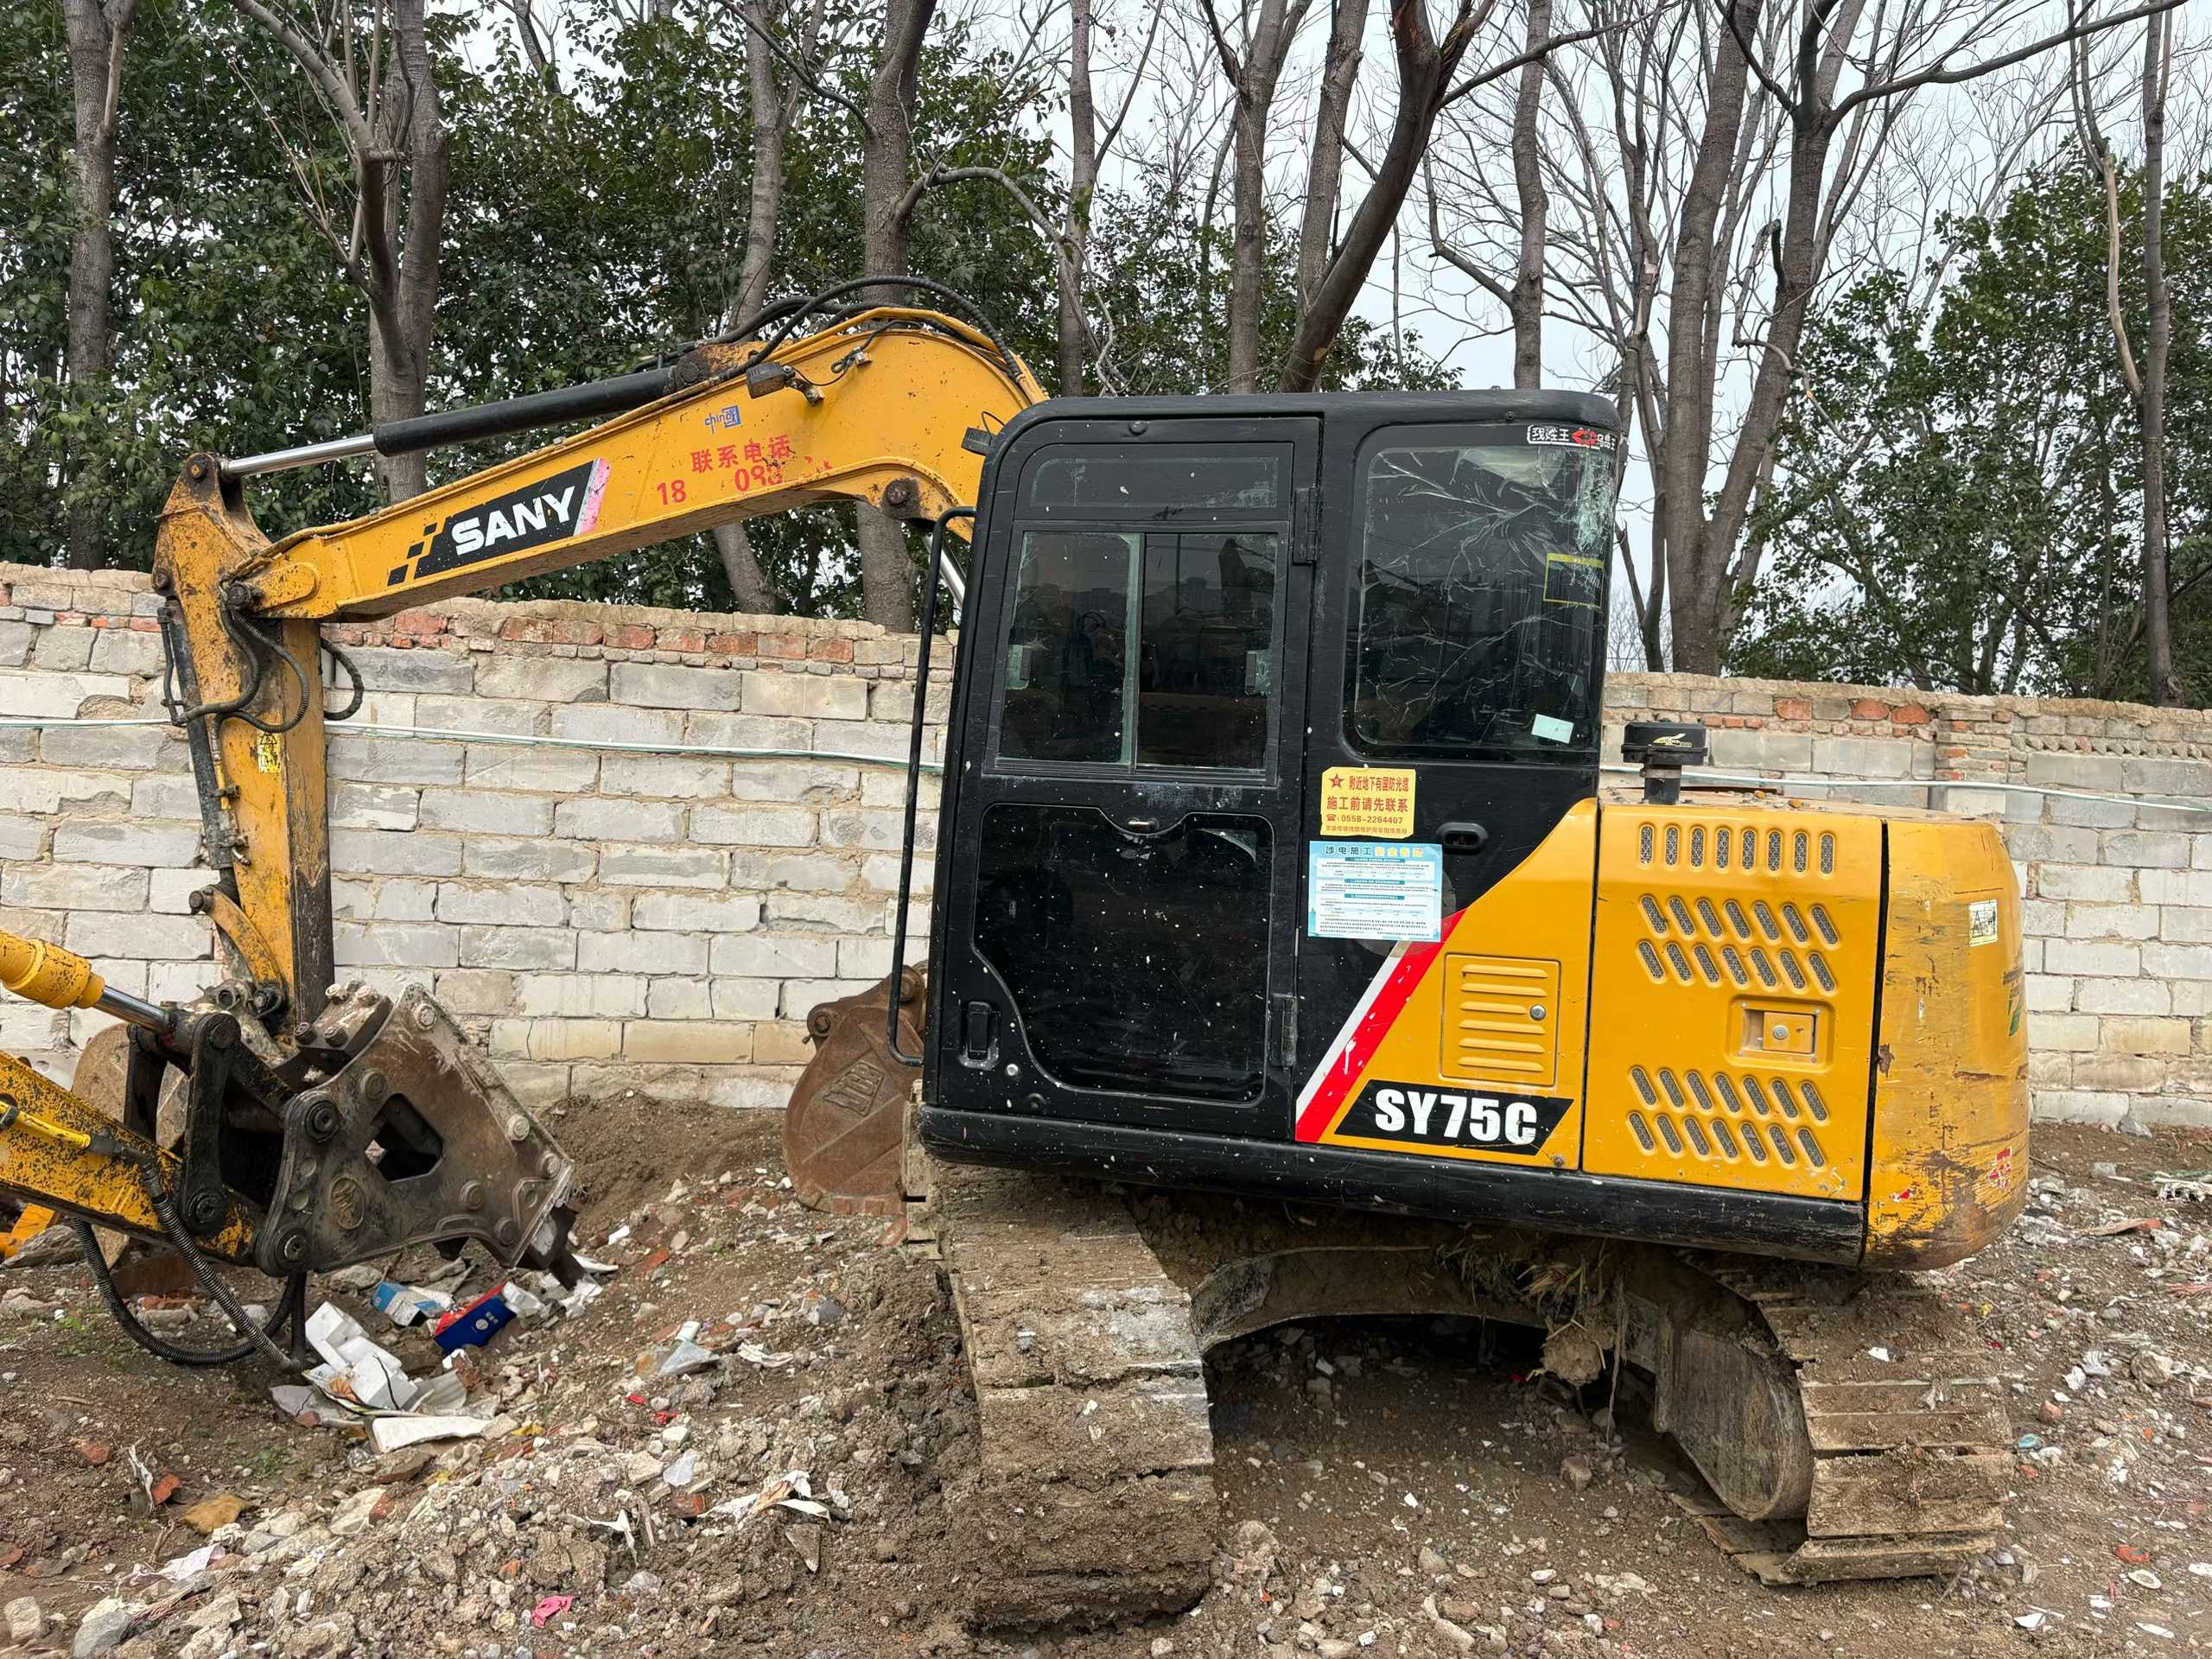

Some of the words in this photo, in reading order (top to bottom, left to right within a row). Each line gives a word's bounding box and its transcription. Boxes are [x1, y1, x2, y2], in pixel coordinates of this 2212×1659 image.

[690, 434, 791, 474] 联系电话
[657, 480, 687, 505] 18
[451, 485, 575, 556] SANY
[1326, 795, 1408, 812] 施工前请先联系
[1375, 1088, 1538, 1146] SY75C
